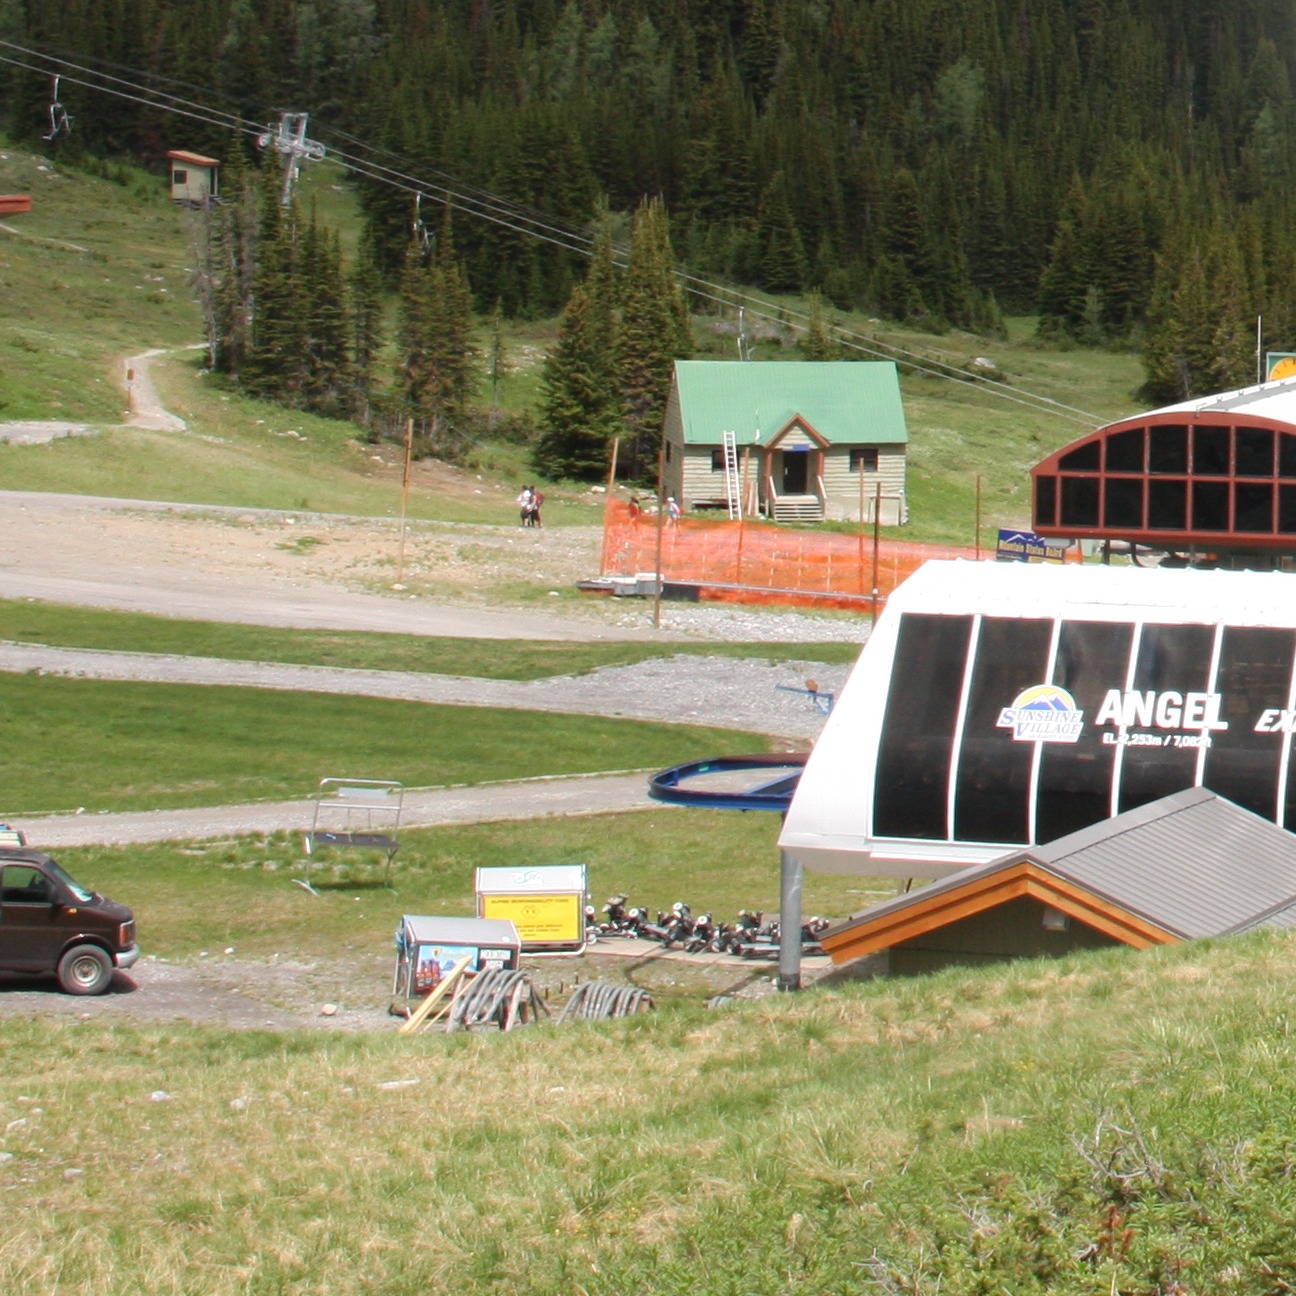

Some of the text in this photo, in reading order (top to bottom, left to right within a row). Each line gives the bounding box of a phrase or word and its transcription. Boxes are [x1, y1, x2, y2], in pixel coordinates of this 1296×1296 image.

[1000, 710, 1081, 725] SUNSHINE
[1095, 689, 1229, 731] ANGEL
[1016, 722, 1080, 737] VILLAGE
